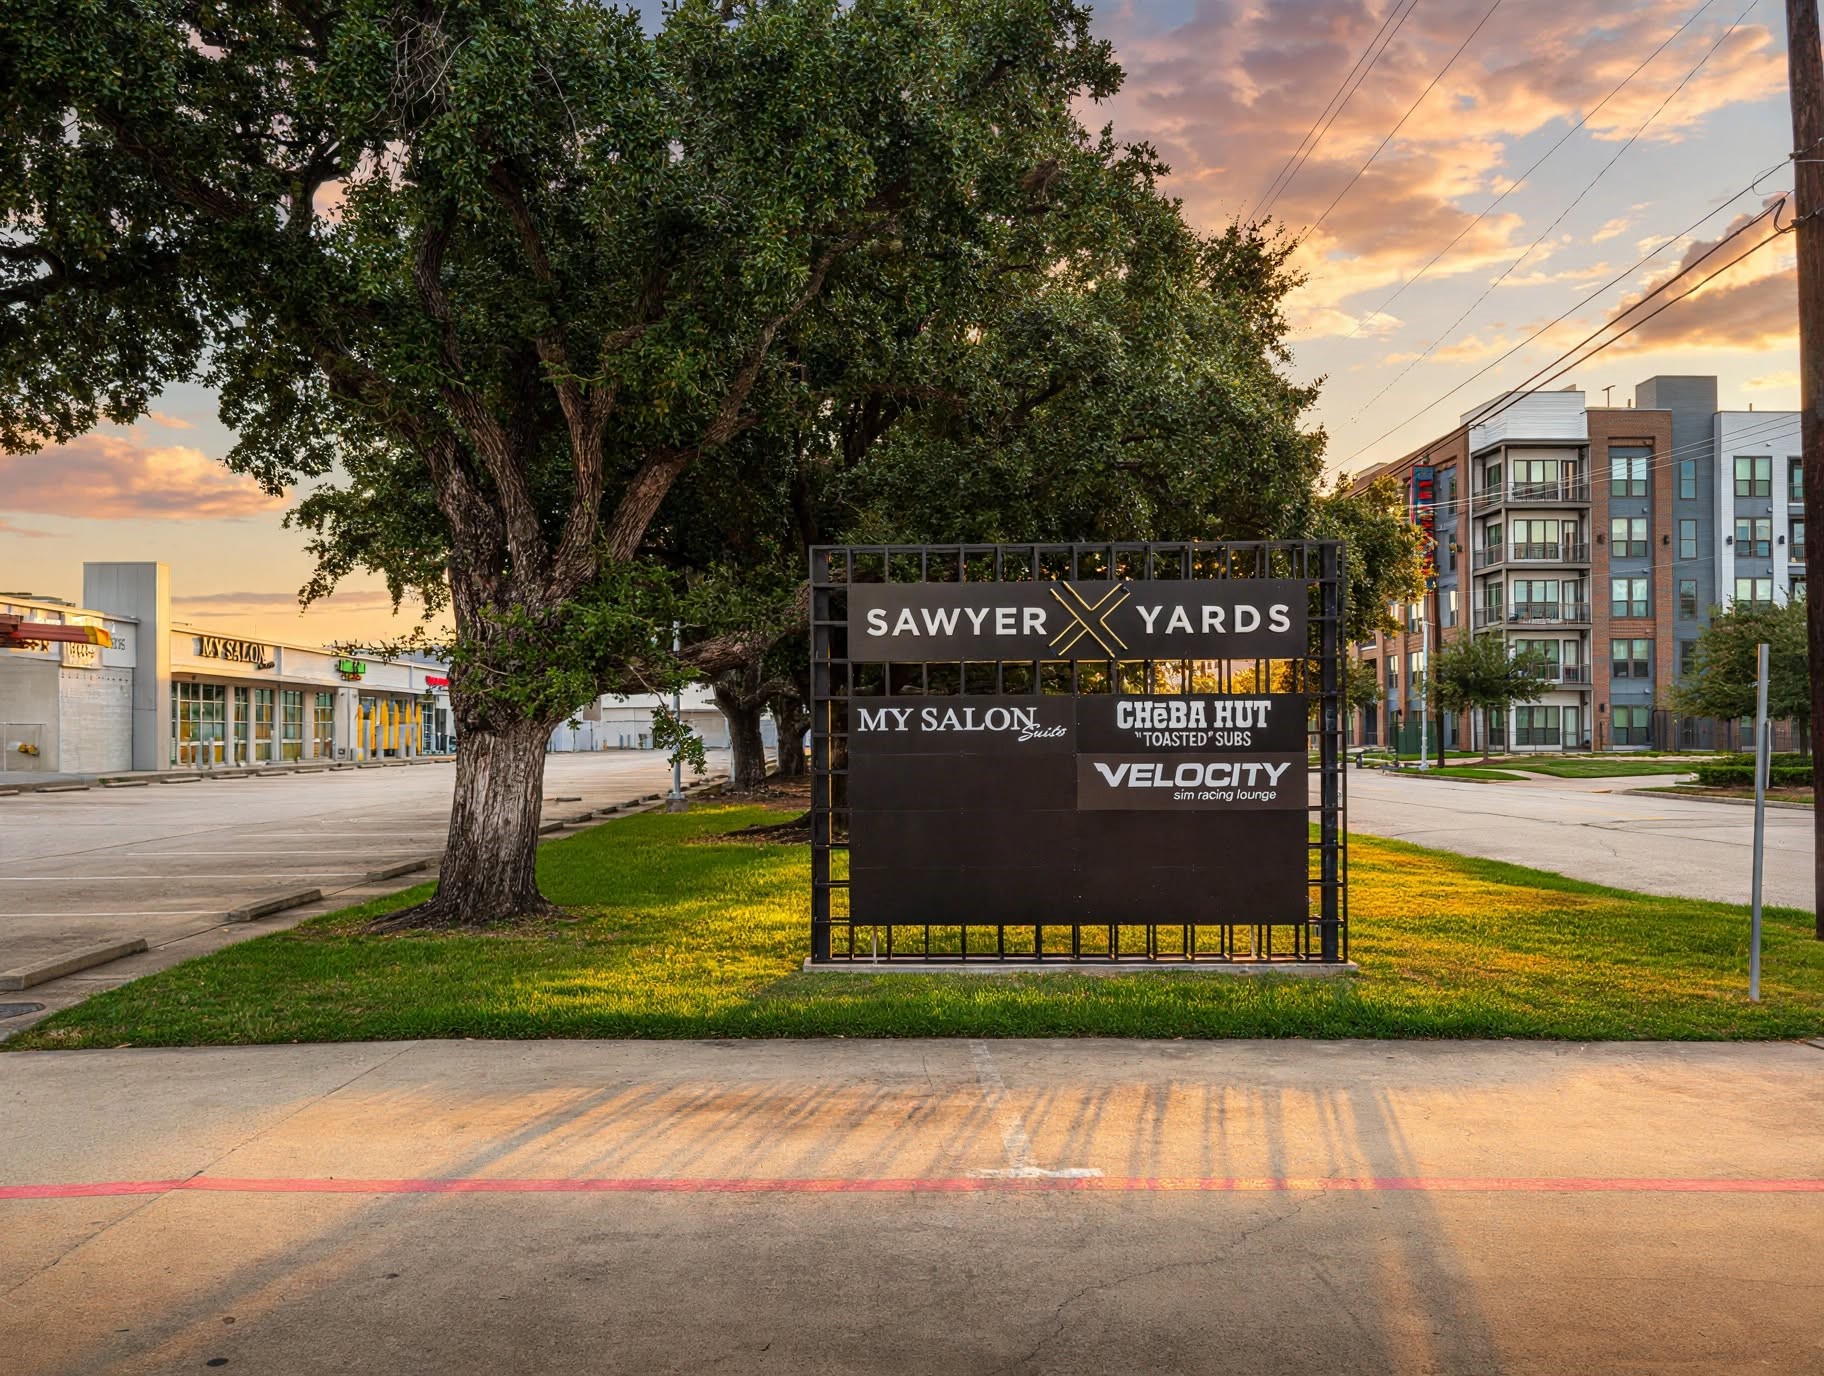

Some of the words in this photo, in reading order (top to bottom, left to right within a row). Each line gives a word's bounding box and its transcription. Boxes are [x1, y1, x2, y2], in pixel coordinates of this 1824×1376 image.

[866, 606, 1048, 637] SAWYER
[1135, 603, 1291, 635] YARDS
[201, 637, 225, 658] MY
[856, 707, 914, 732] MY
[921, 706, 1037, 732] SALON
[1213, 700, 1272, 729] HUT
[1215, 730, 1252, 747] SUBS
[1093, 762, 1292, 788] VELOCITY
[1173, 788, 1195, 801] sim
[1197, 788, 1234, 802] racing
[1236, 788, 1277, 802] lounge
